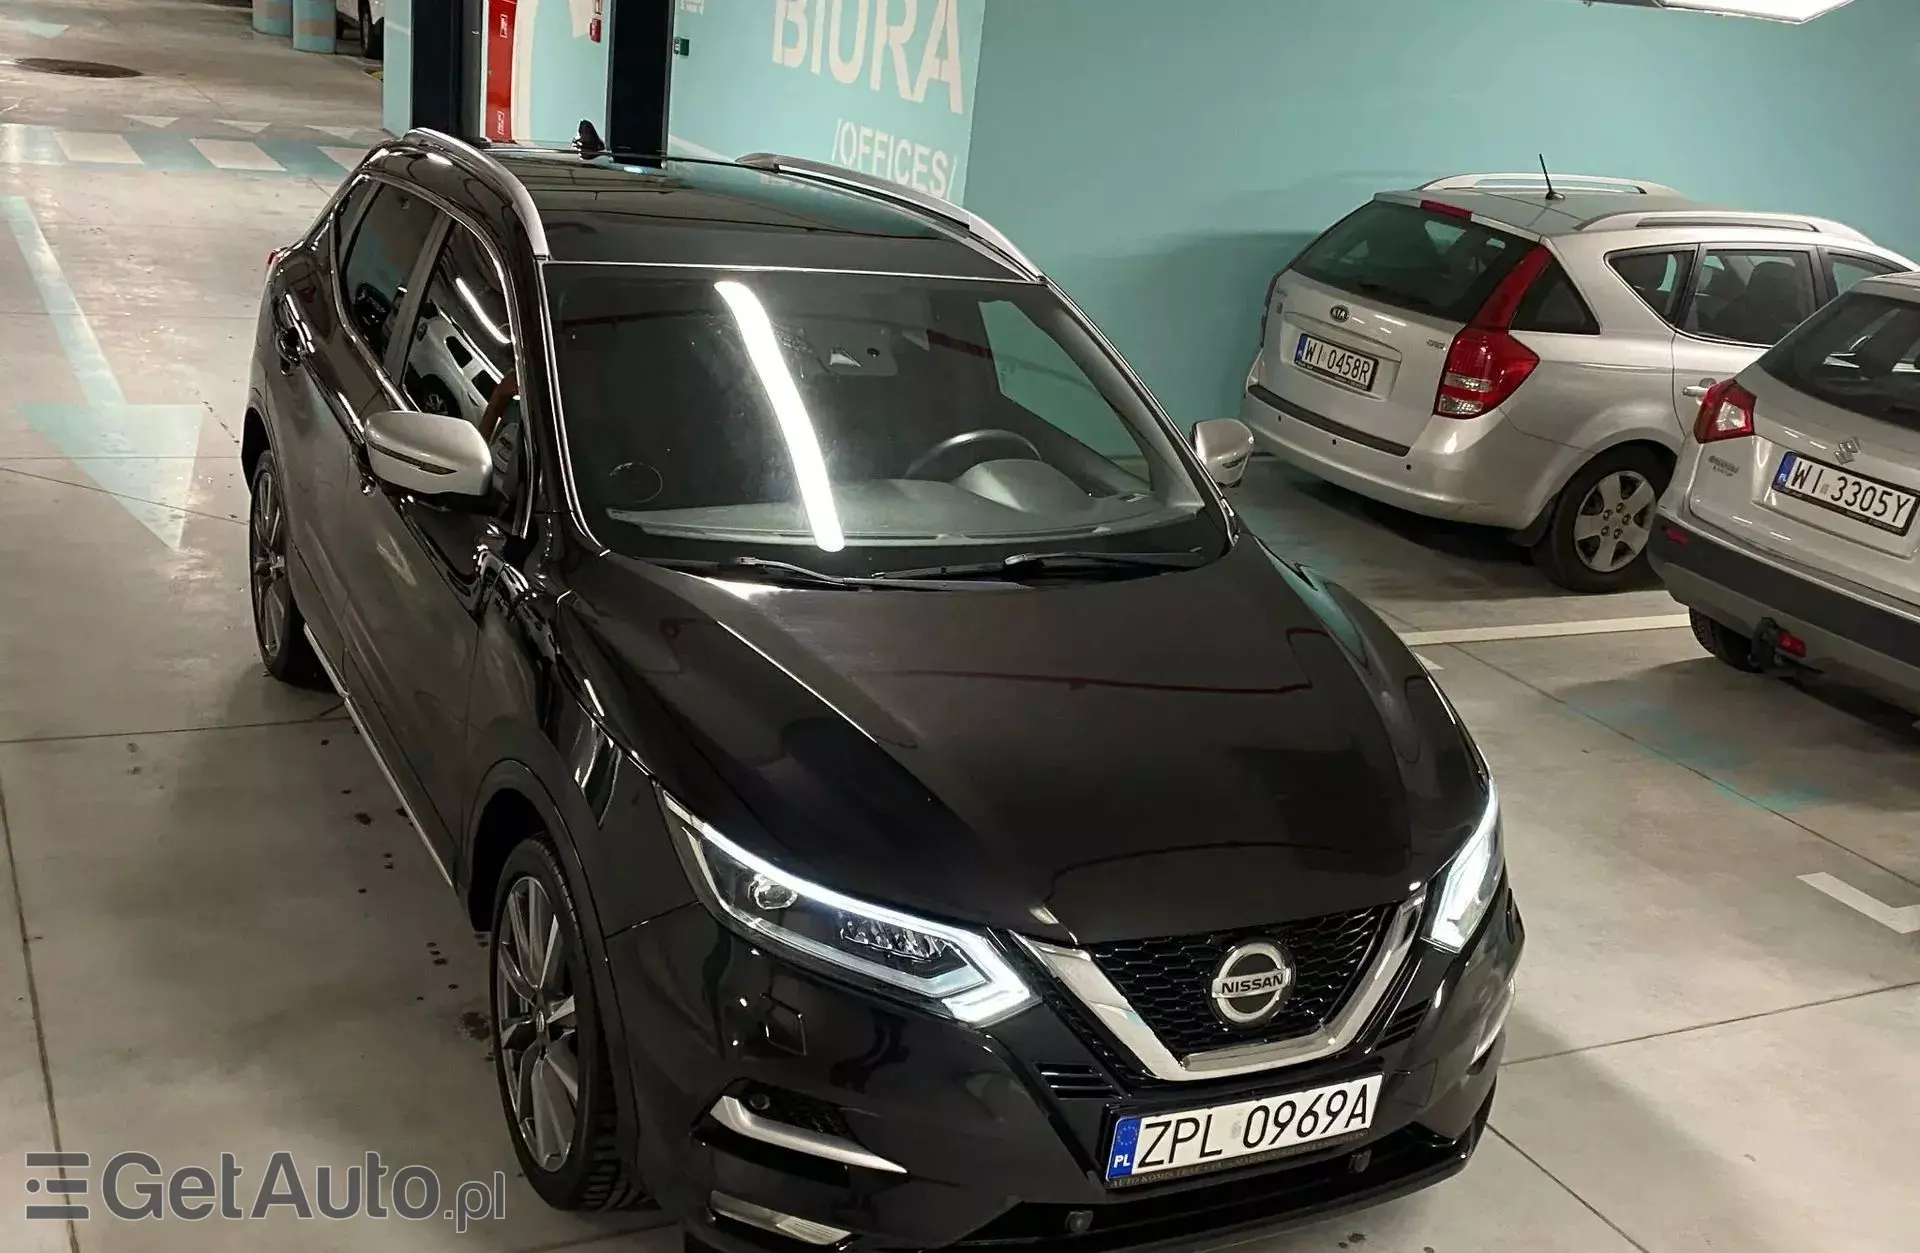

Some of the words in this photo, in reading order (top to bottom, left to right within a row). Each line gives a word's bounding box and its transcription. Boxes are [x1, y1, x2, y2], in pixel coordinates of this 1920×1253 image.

[772, 0, 963, 114] BIURA
[1304, 340, 1323, 365] WI
[1327, 351, 1370, 383] 0458R
[1791, 460, 1824, 494] WI
[1831, 476, 1911, 523] 3305Y
[1222, 973, 1283, 993] NISSAN
[1137, 1113, 1223, 1168] ZPL
[1242, 1084, 1368, 1149] 0969A
[1113, 1153, 1131, 1168] PL
